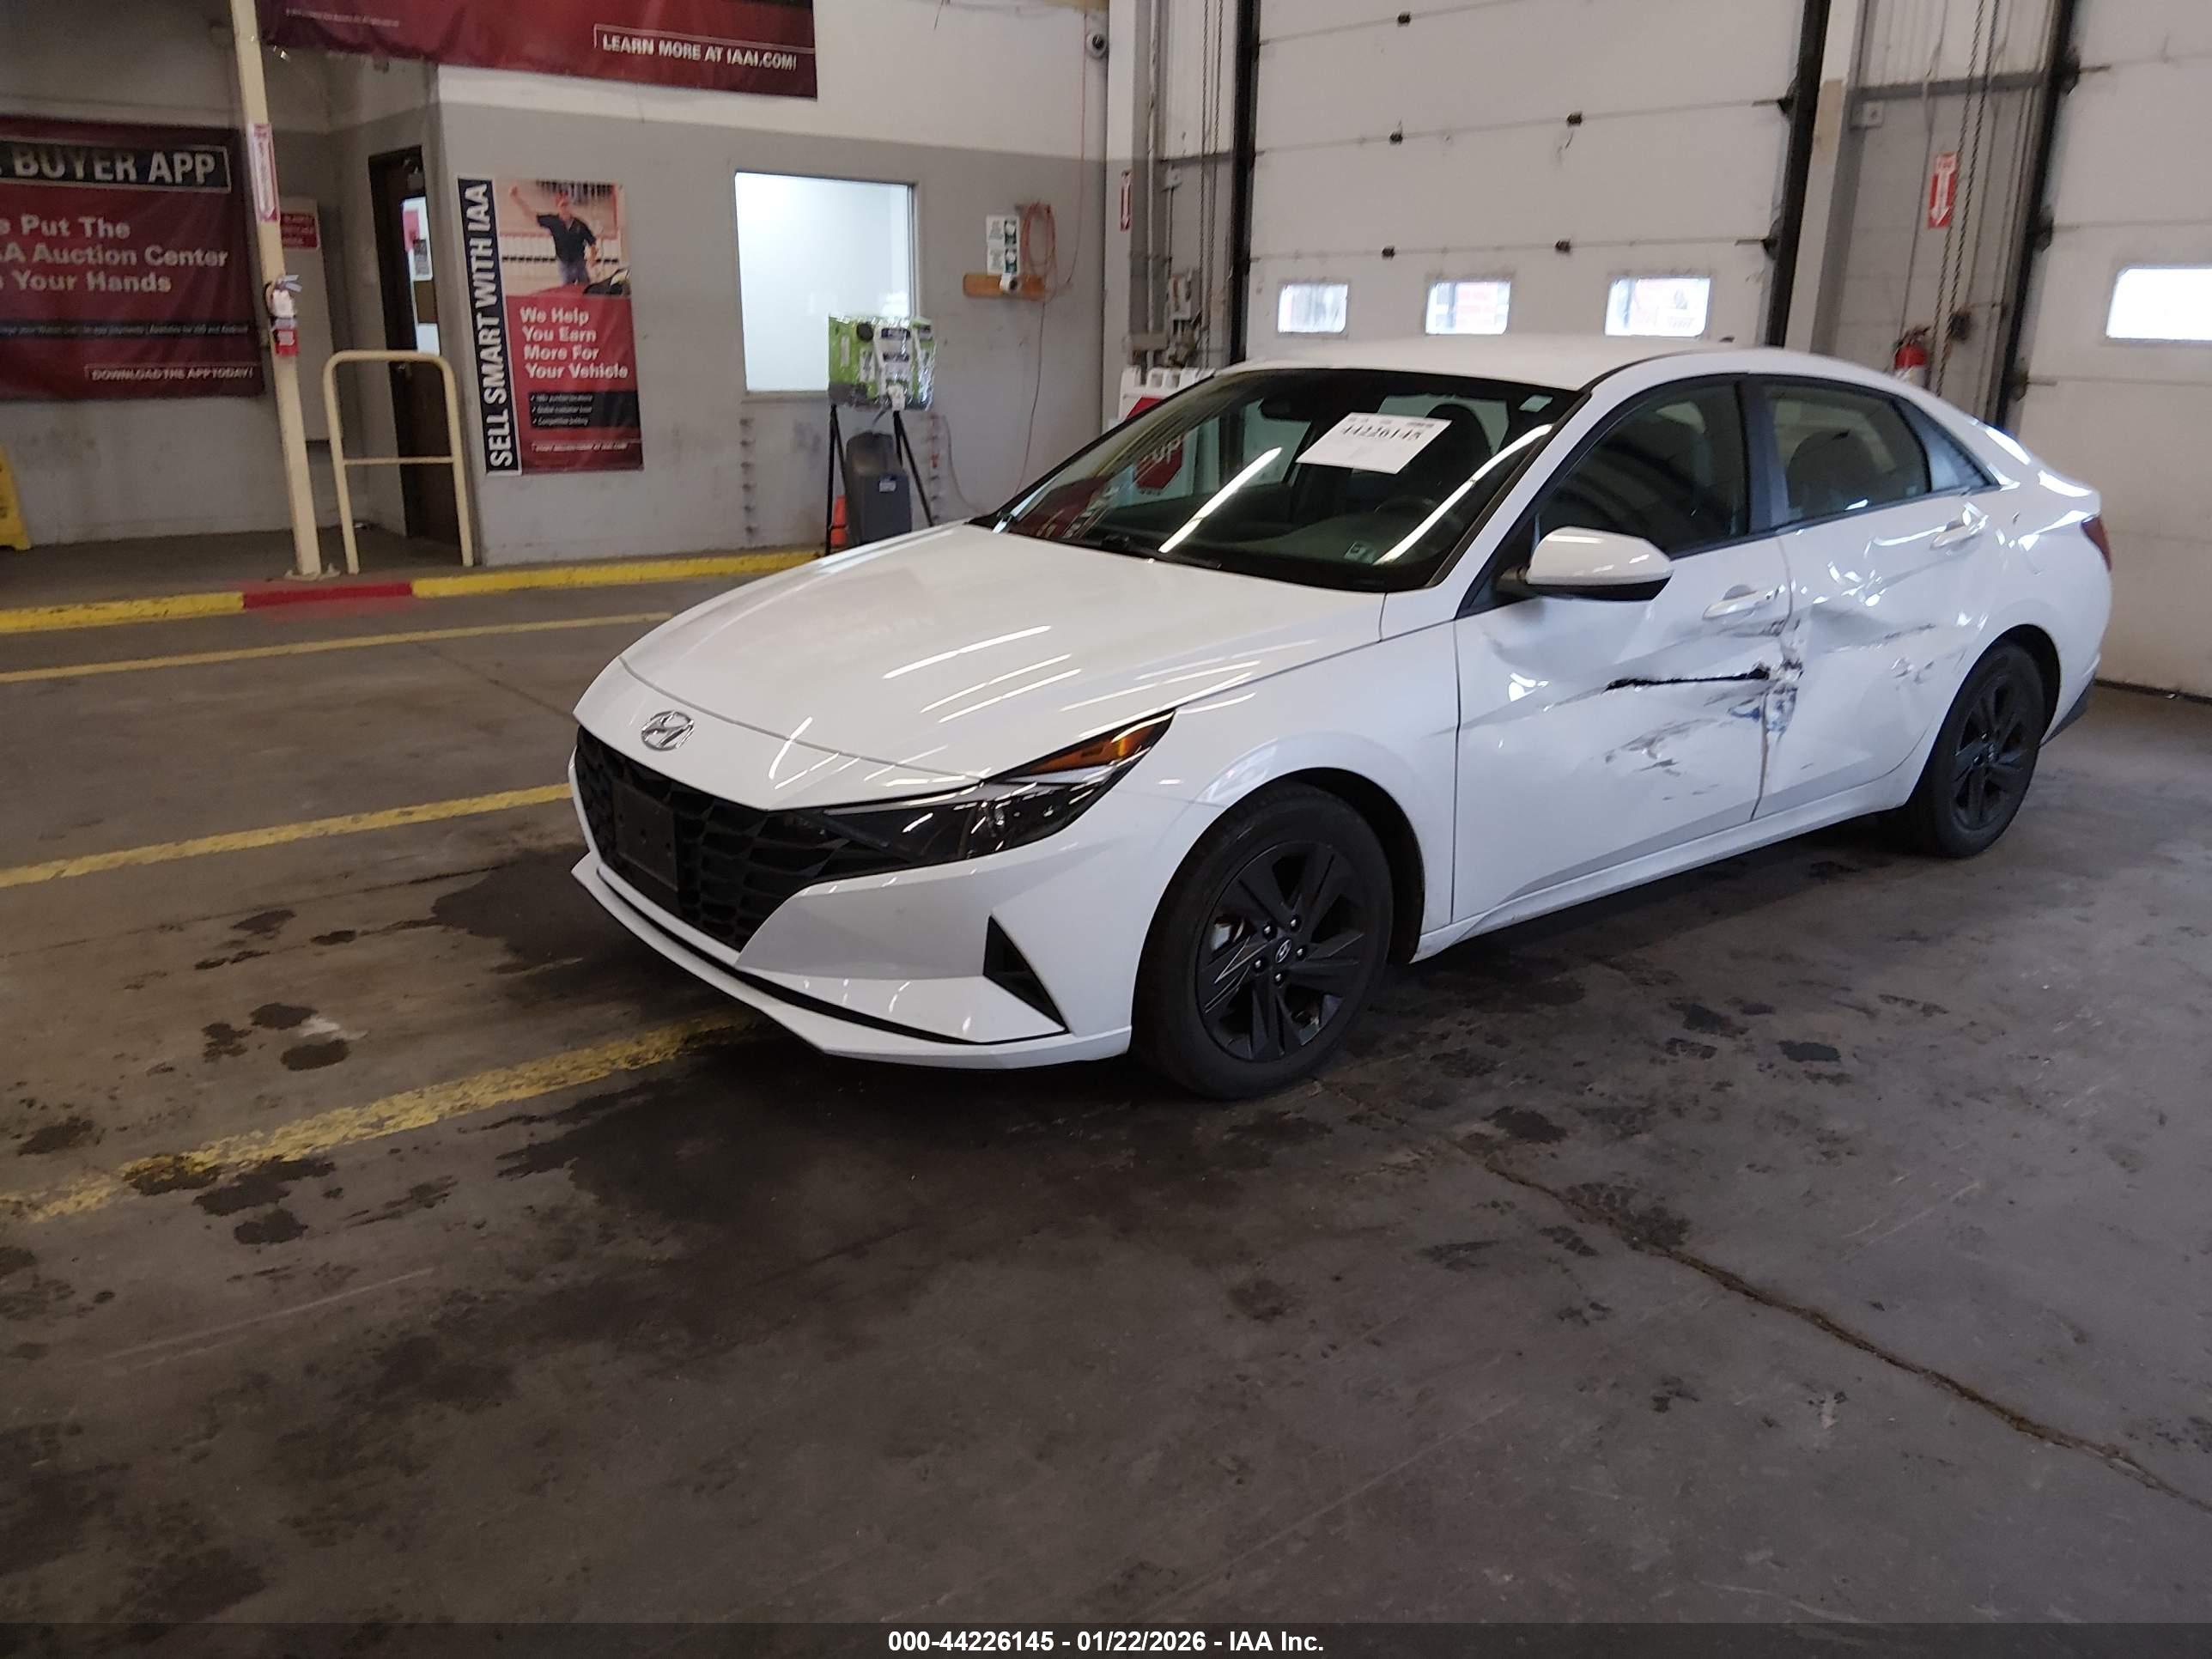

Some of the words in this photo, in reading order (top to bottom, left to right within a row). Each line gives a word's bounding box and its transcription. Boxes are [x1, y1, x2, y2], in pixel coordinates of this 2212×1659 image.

[603, 34, 654, 55] LEARN
[659, 40, 702, 61] MORE
[704, 46, 724, 63] AT
[726, 48, 797, 70] IAAI.COM!
[12, 146, 137, 182] BUYER
[148, 150, 216, 185] APP
[465, 183, 492, 233] IAA
[21, 213, 71, 237] Put
[78, 216, 131, 239] The
[33, 241, 137, 266] Auction
[144, 244, 229, 267] Center
[12, 269, 78, 292] Your
[87, 270, 173, 293] Hands
[468, 238, 498, 309] WITH
[520, 307, 547, 324] We
[551, 307, 590, 327] Help
[522, 325, 554, 343] You
[559, 326, 597, 343] Earn
[476, 313, 507, 404] SMART
[523, 344, 568, 361] More
[572, 343, 600, 361] For
[525, 362, 565, 379] Your
[568, 362, 629, 379] Vehicle
[486, 407, 514, 467] SELL
